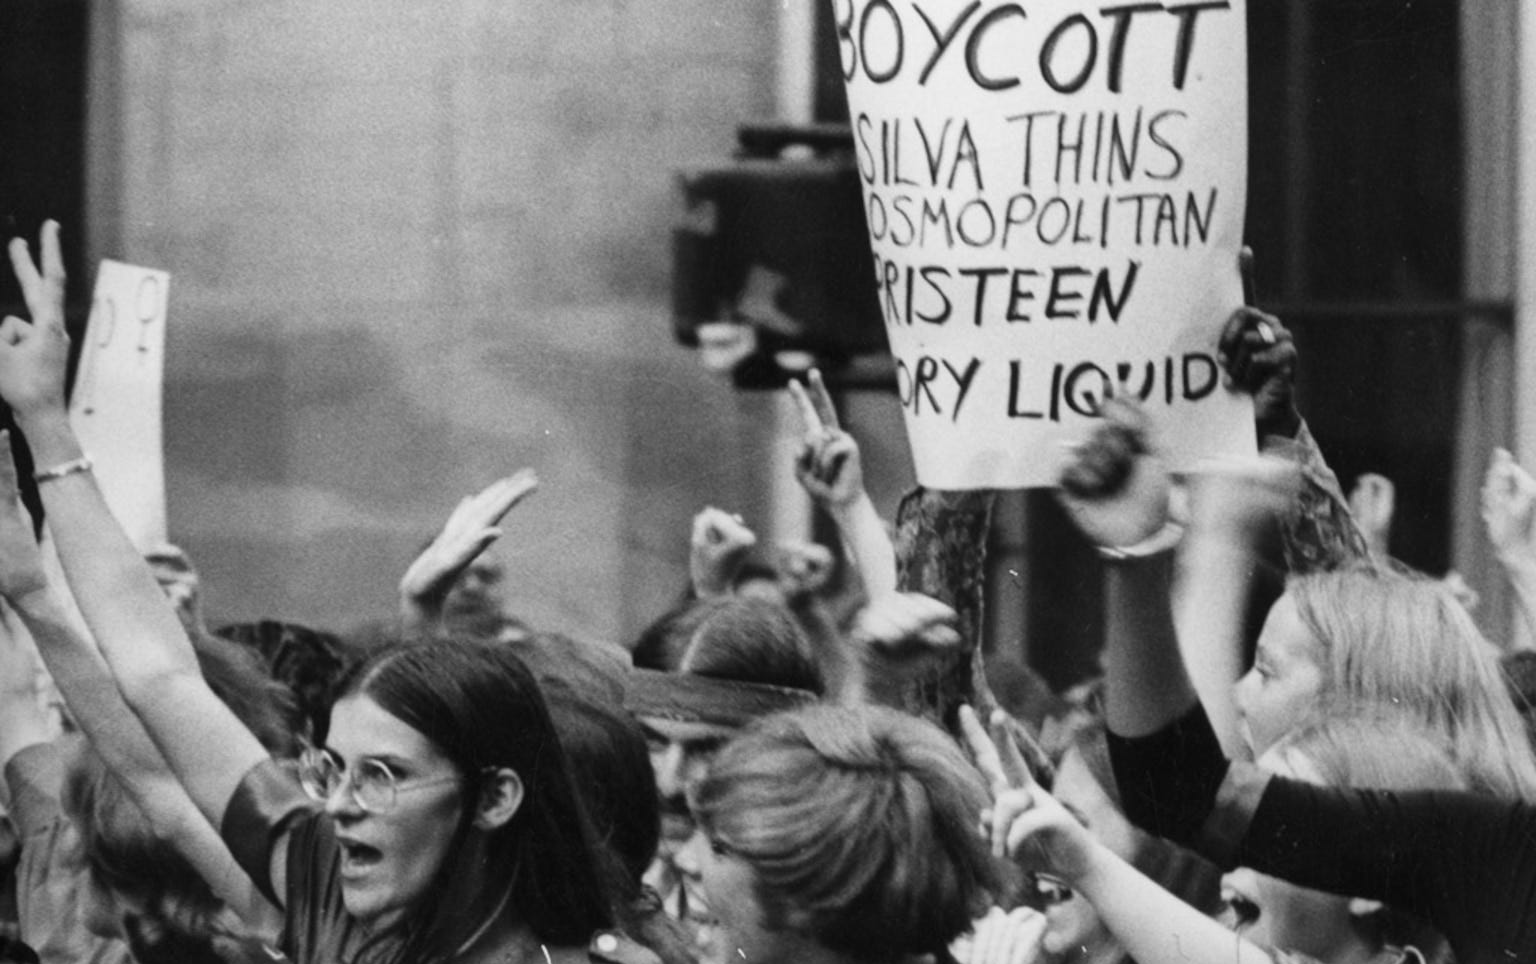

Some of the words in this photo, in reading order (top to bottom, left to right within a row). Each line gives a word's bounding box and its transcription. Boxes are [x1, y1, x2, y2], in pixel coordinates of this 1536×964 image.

[857, 112, 984, 190] SILVA
[1005, 106, 1188, 187] THINS
[1007, 352, 1219, 422] LIQUID
